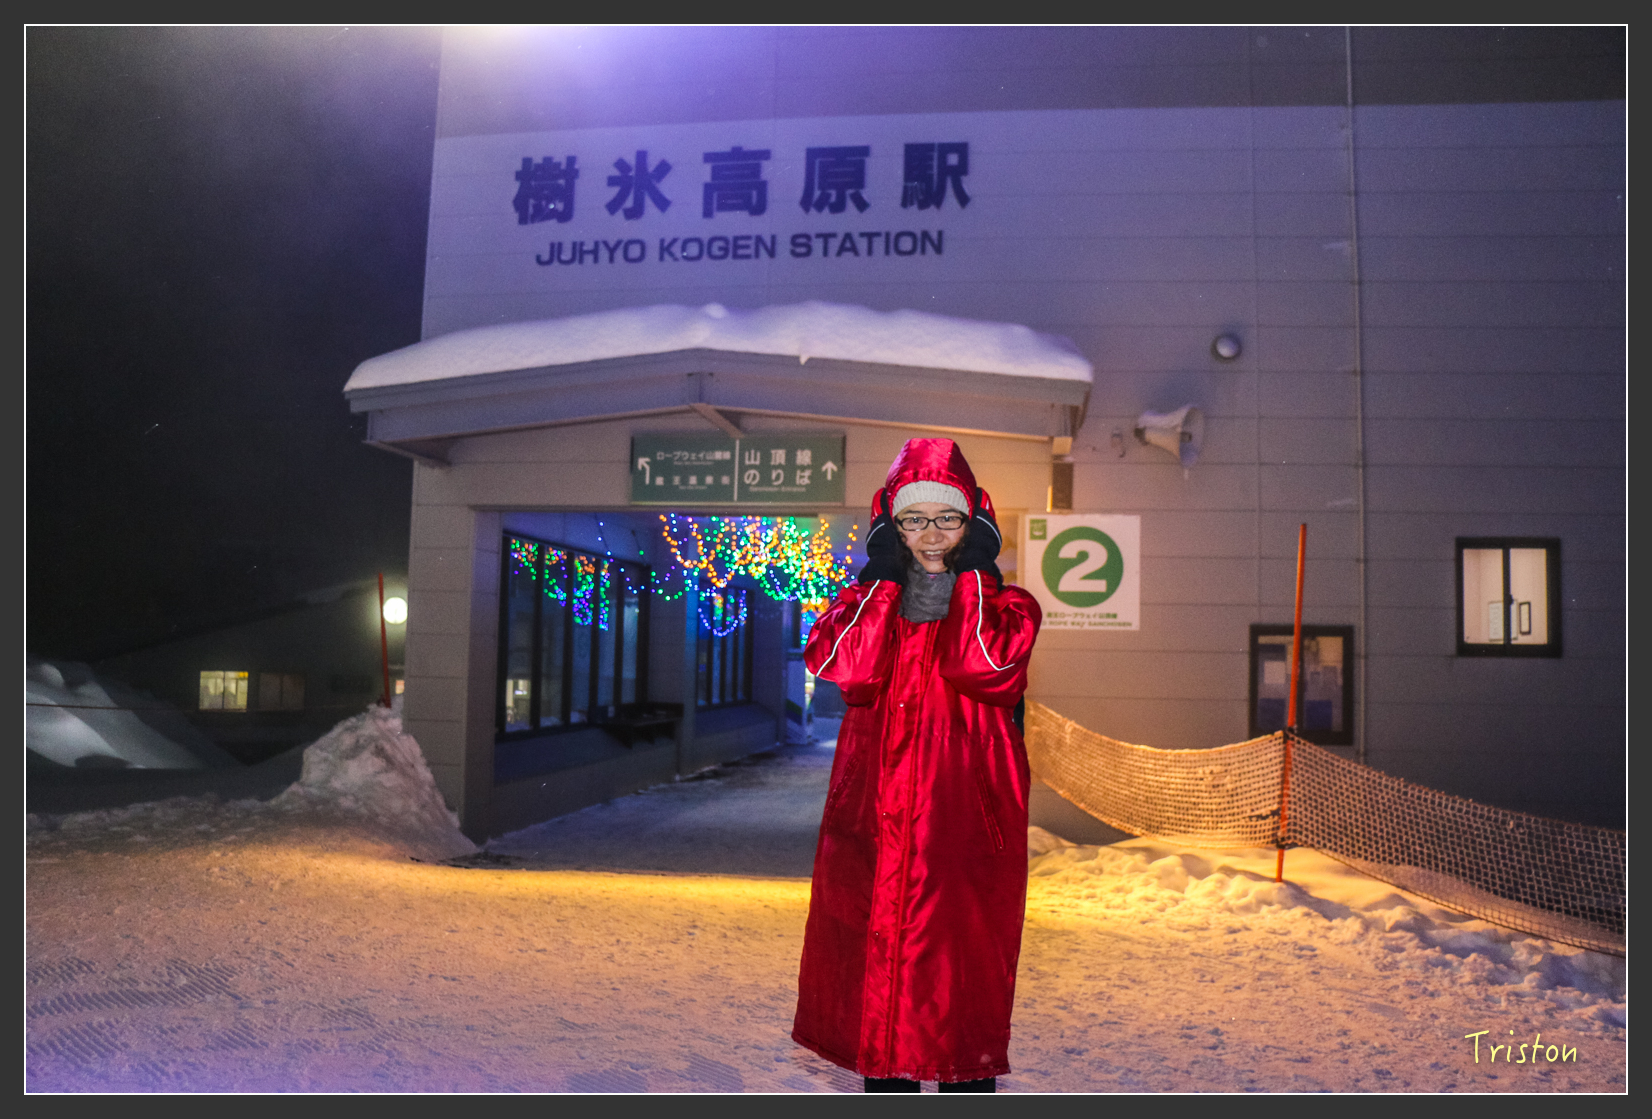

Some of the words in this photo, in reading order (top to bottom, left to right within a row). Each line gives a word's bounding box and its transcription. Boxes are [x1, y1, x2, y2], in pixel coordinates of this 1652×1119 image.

[512, 141, 972, 225] 樹氷高原駅
[536, 239, 646, 266] JUHYO
[658, 234, 777, 262] KOGEN
[789, 229, 944, 259] STATION
[744, 449, 813, 466] 山頂線
[743, 468, 813, 486] のりば
[1058, 539, 1108, 592] 2
